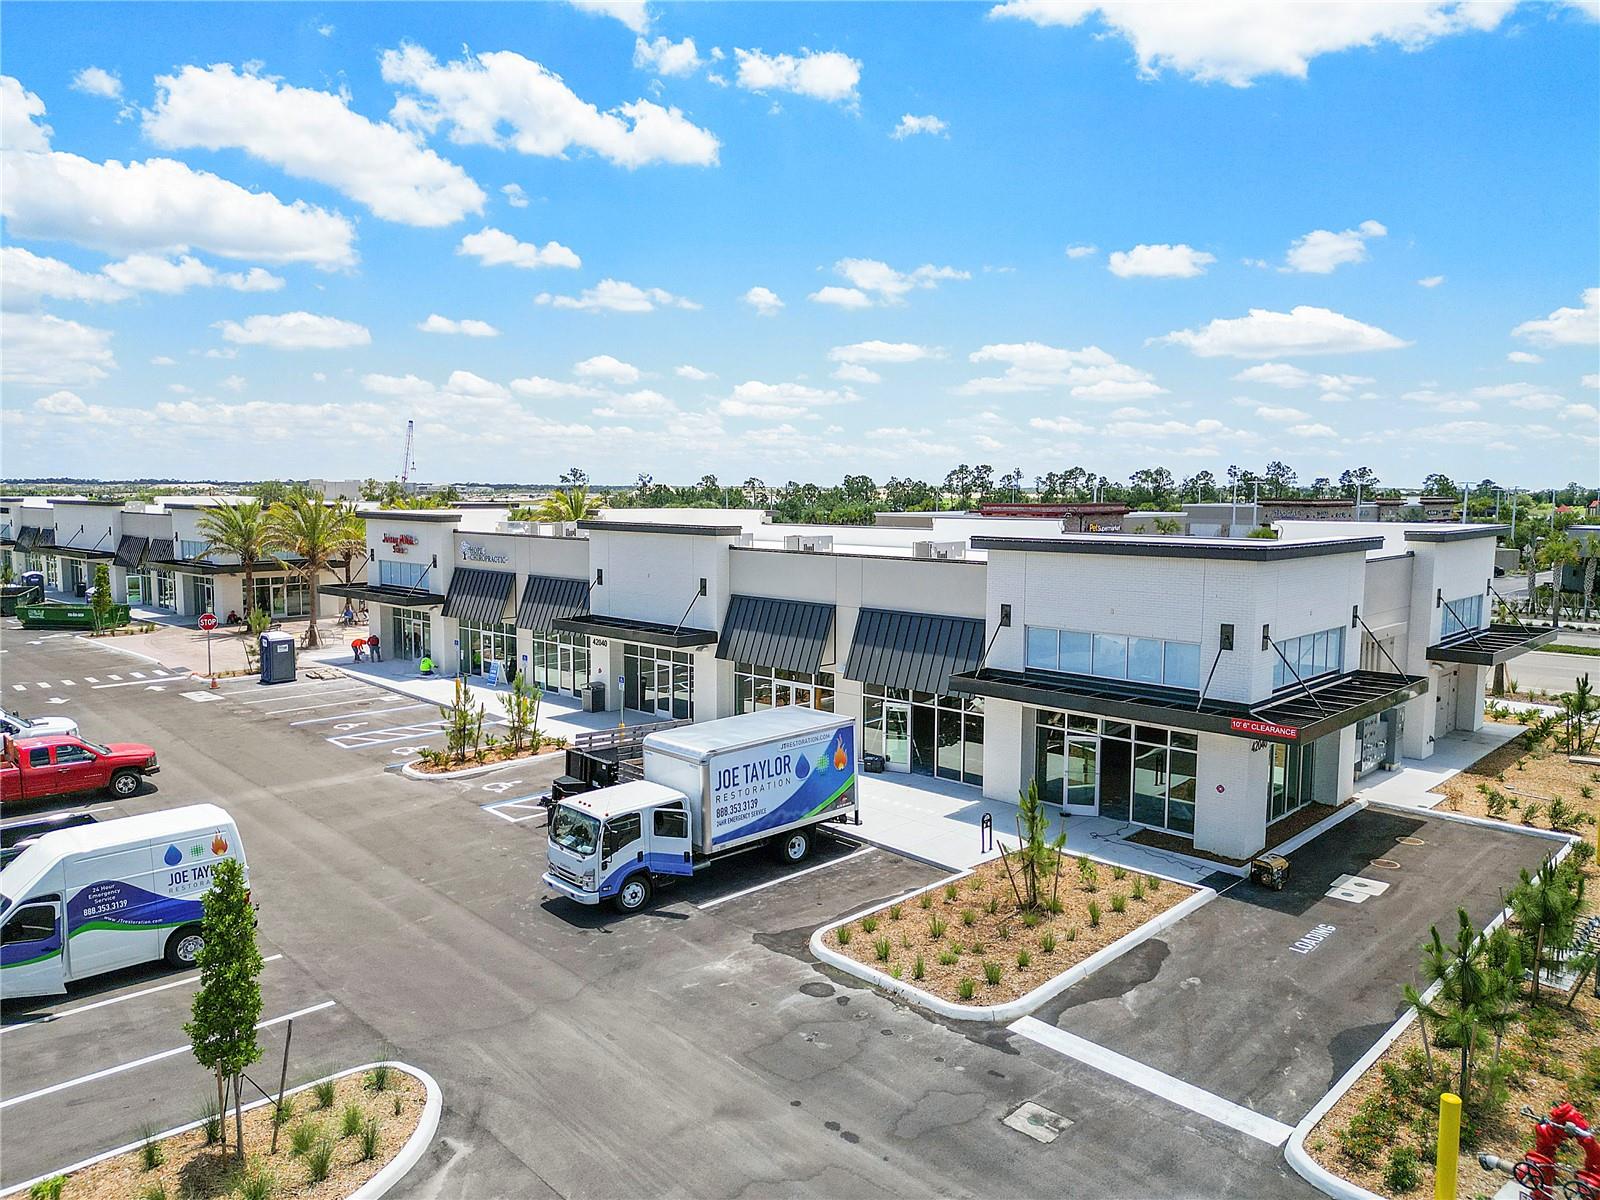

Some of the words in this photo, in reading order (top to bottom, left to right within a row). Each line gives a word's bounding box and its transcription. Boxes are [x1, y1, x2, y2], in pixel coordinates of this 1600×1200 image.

[200, 617, 217, 626] STOP
[592, 638, 608, 647] 42040
[1251, 723, 1297, 737] CLEARANCE
[714, 766, 740, 792] JOE
[743, 754, 792, 784] TAYLOR
[715, 777, 792, 804] RESTORATION
[716, 798, 759, 819] 888.353.3139
[727, 812, 750, 825] EMERGENCY
[751, 807, 767, 818] SERVICE
[168, 870, 189, 887] JOE
[168, 879, 212, 894] RESTORA
[88, 888, 121, 900] Emergency
[94, 895, 116, 904] Service
[83, 899, 128, 917] 888.353.3139
[1289, 923, 1337, 955] LOADING
